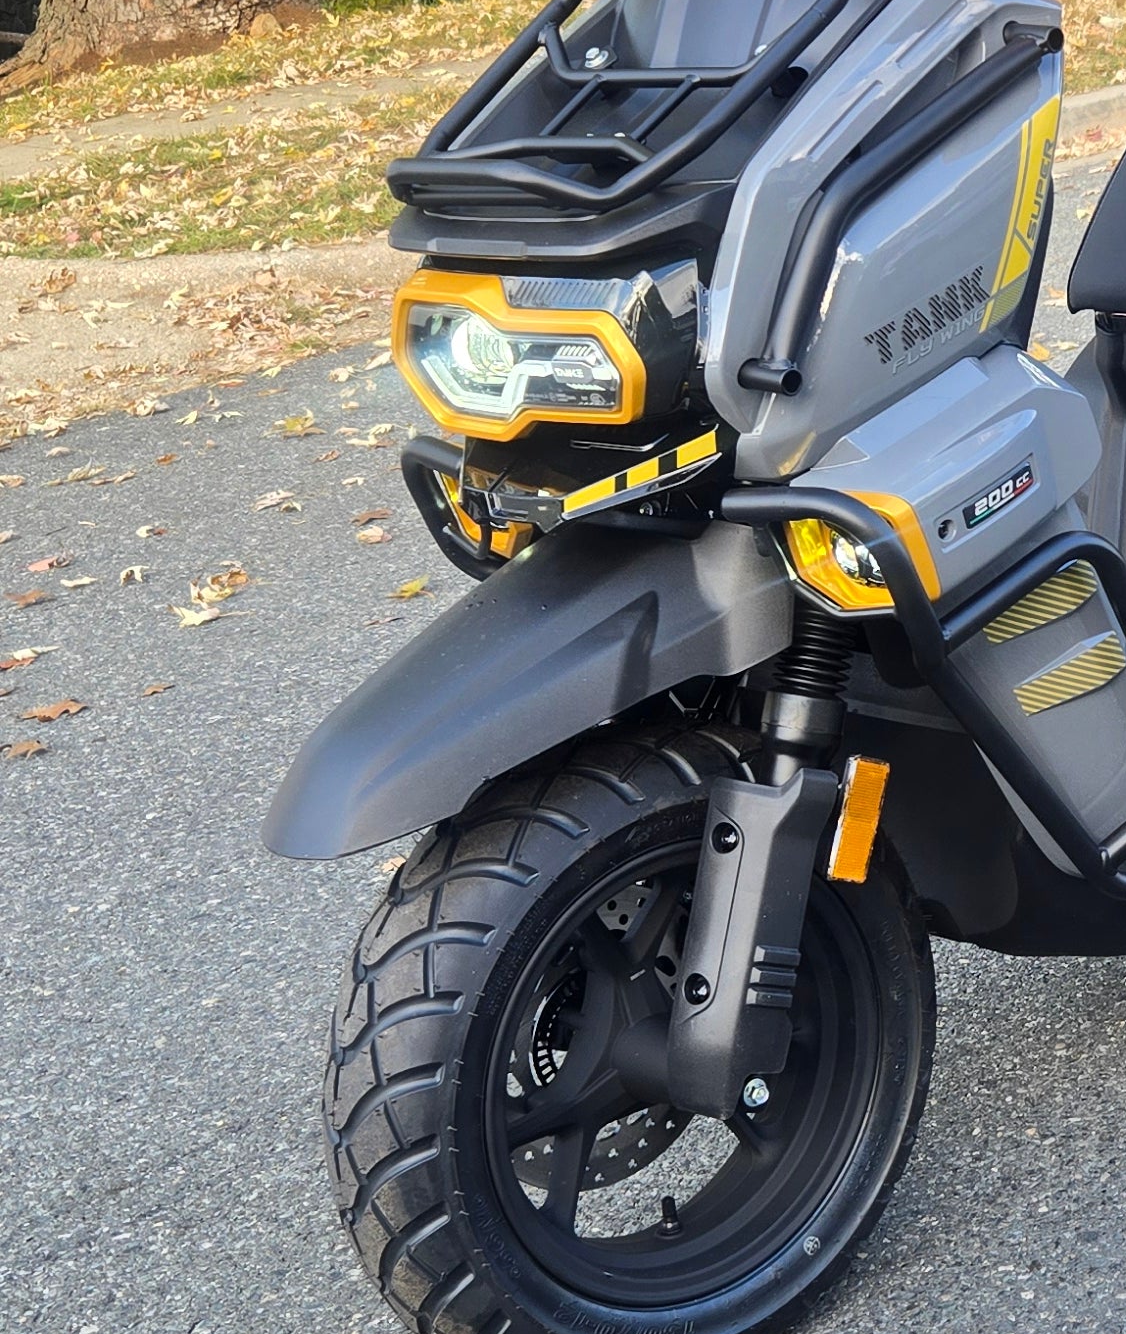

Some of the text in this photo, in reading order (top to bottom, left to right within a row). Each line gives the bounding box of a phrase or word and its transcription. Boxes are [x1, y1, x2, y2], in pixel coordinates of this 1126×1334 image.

[1026, 137, 1055, 242] SUPER
[864, 265, 991, 365] TANK
[891, 305, 986, 375] FLY WING
